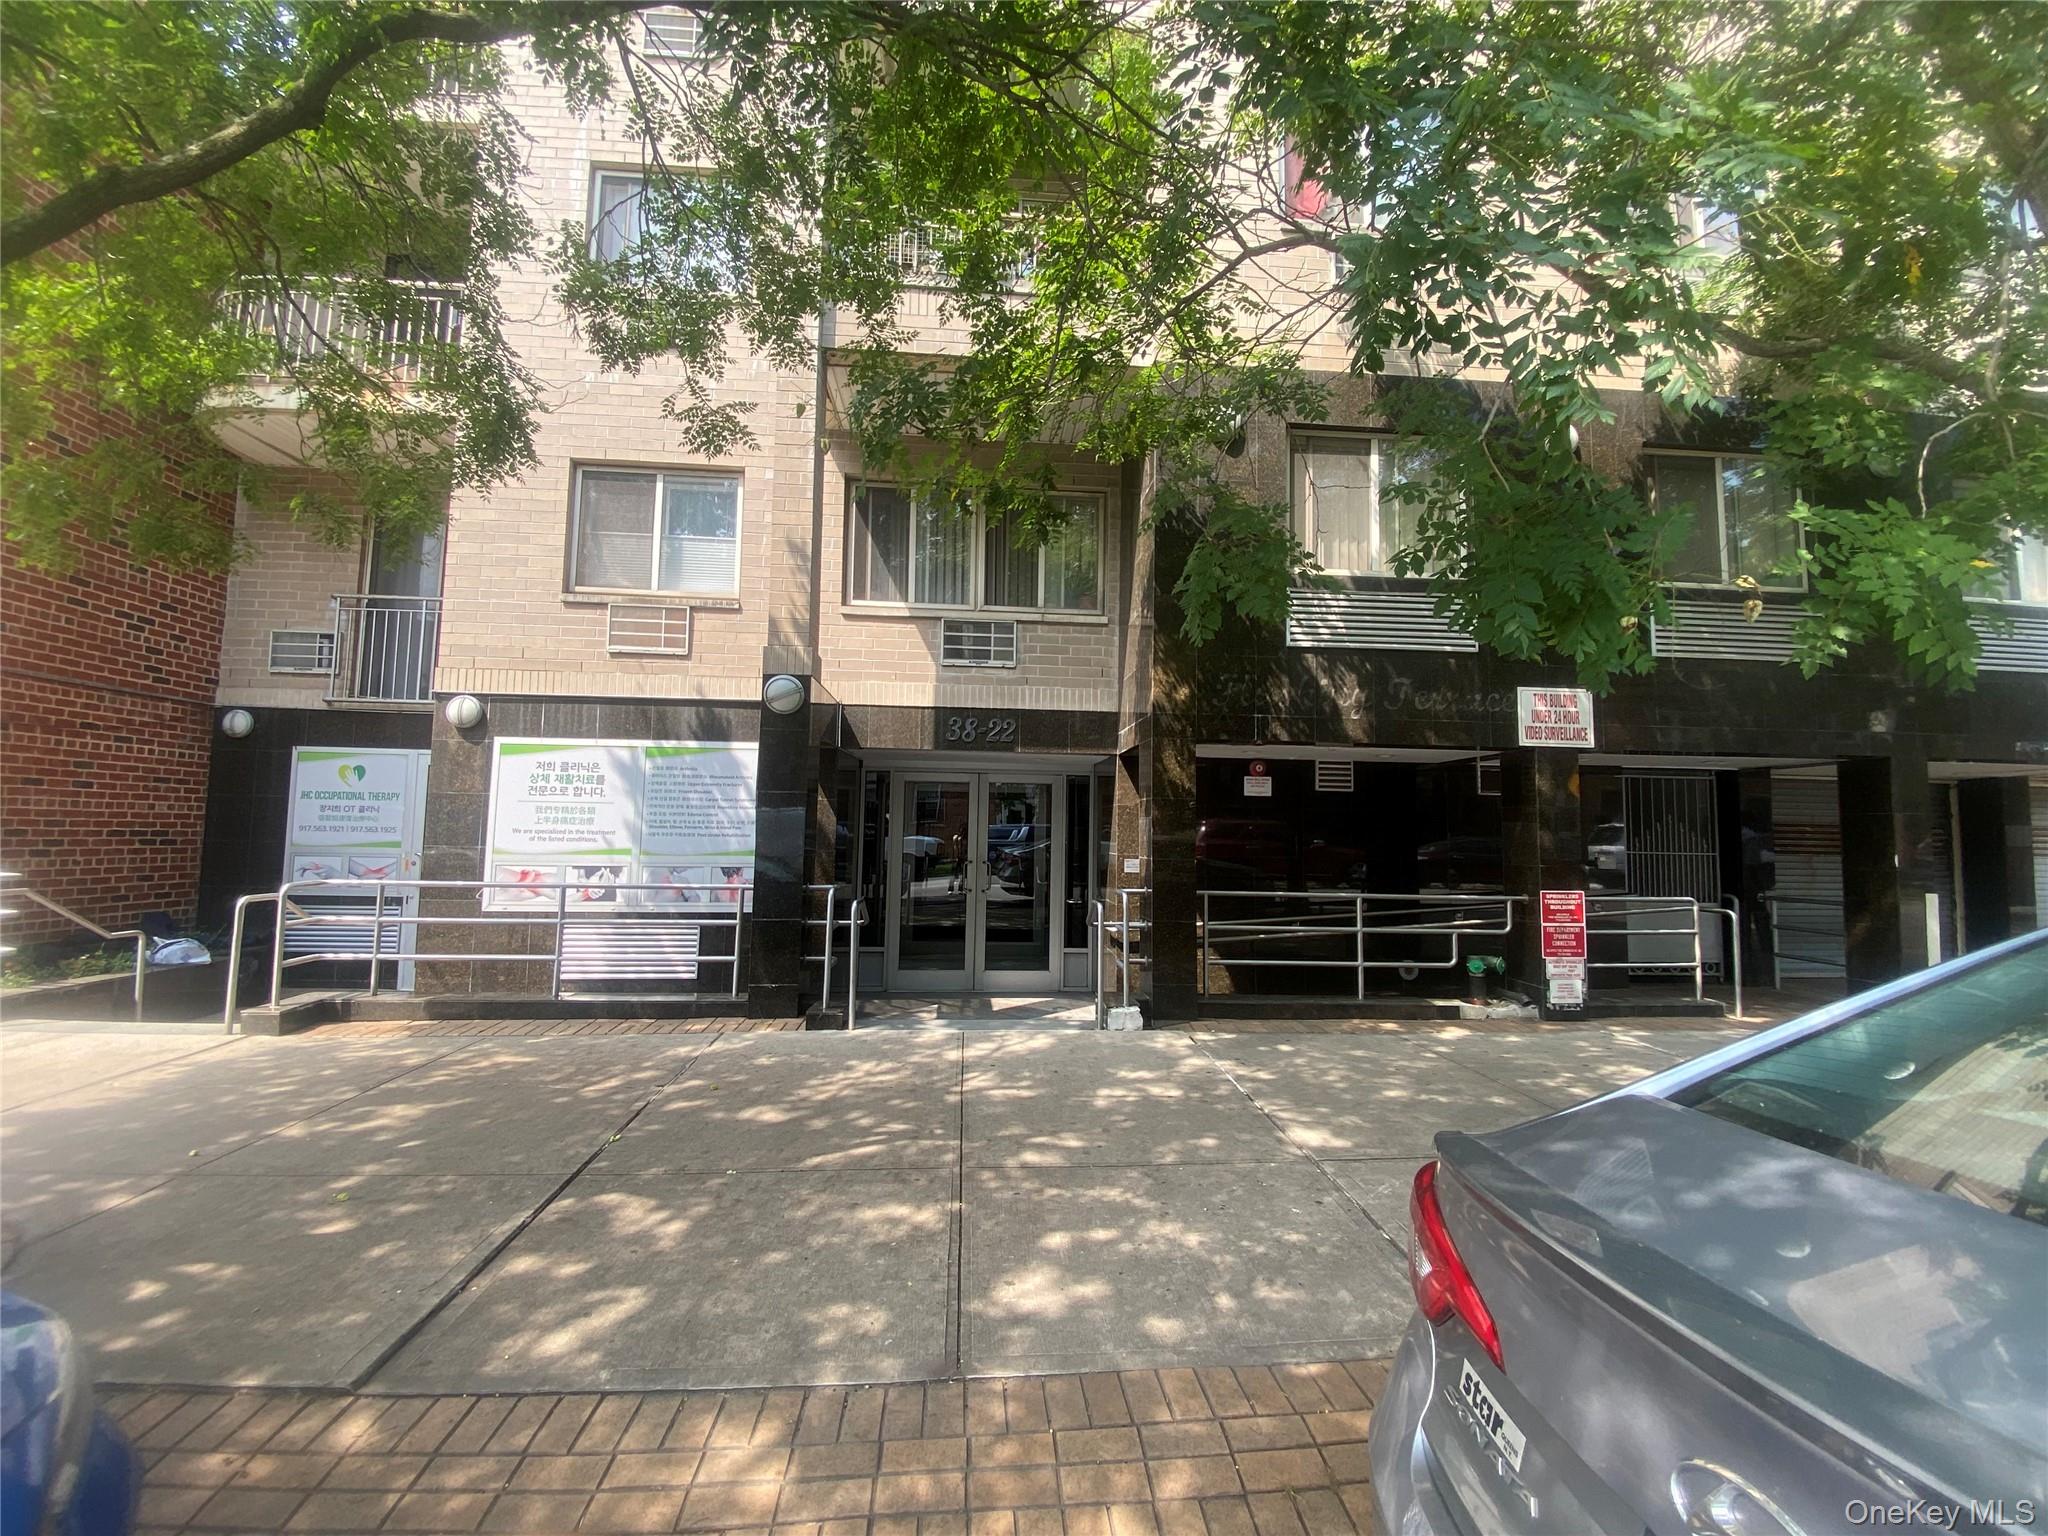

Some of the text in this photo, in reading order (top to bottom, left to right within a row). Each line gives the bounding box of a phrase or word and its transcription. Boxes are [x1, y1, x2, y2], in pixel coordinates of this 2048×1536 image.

[1533, 693, 1578, 709] THIS BUILDING
[1531, 709, 1580, 725] UNDER 24 HOUR
[946, 716, 1017, 742] 38-22
[1524, 725, 1589, 742] VIDEO SURVEILLANCE
[300, 790, 401, 801] JHC OCCUPATIONAL THERAPY
[528, 785, 570, 797] 전문으로
[343, 805, 356, 813] OT
[534, 828, 567, 836] specialized
[1463, 1372, 1504, 1437] star
